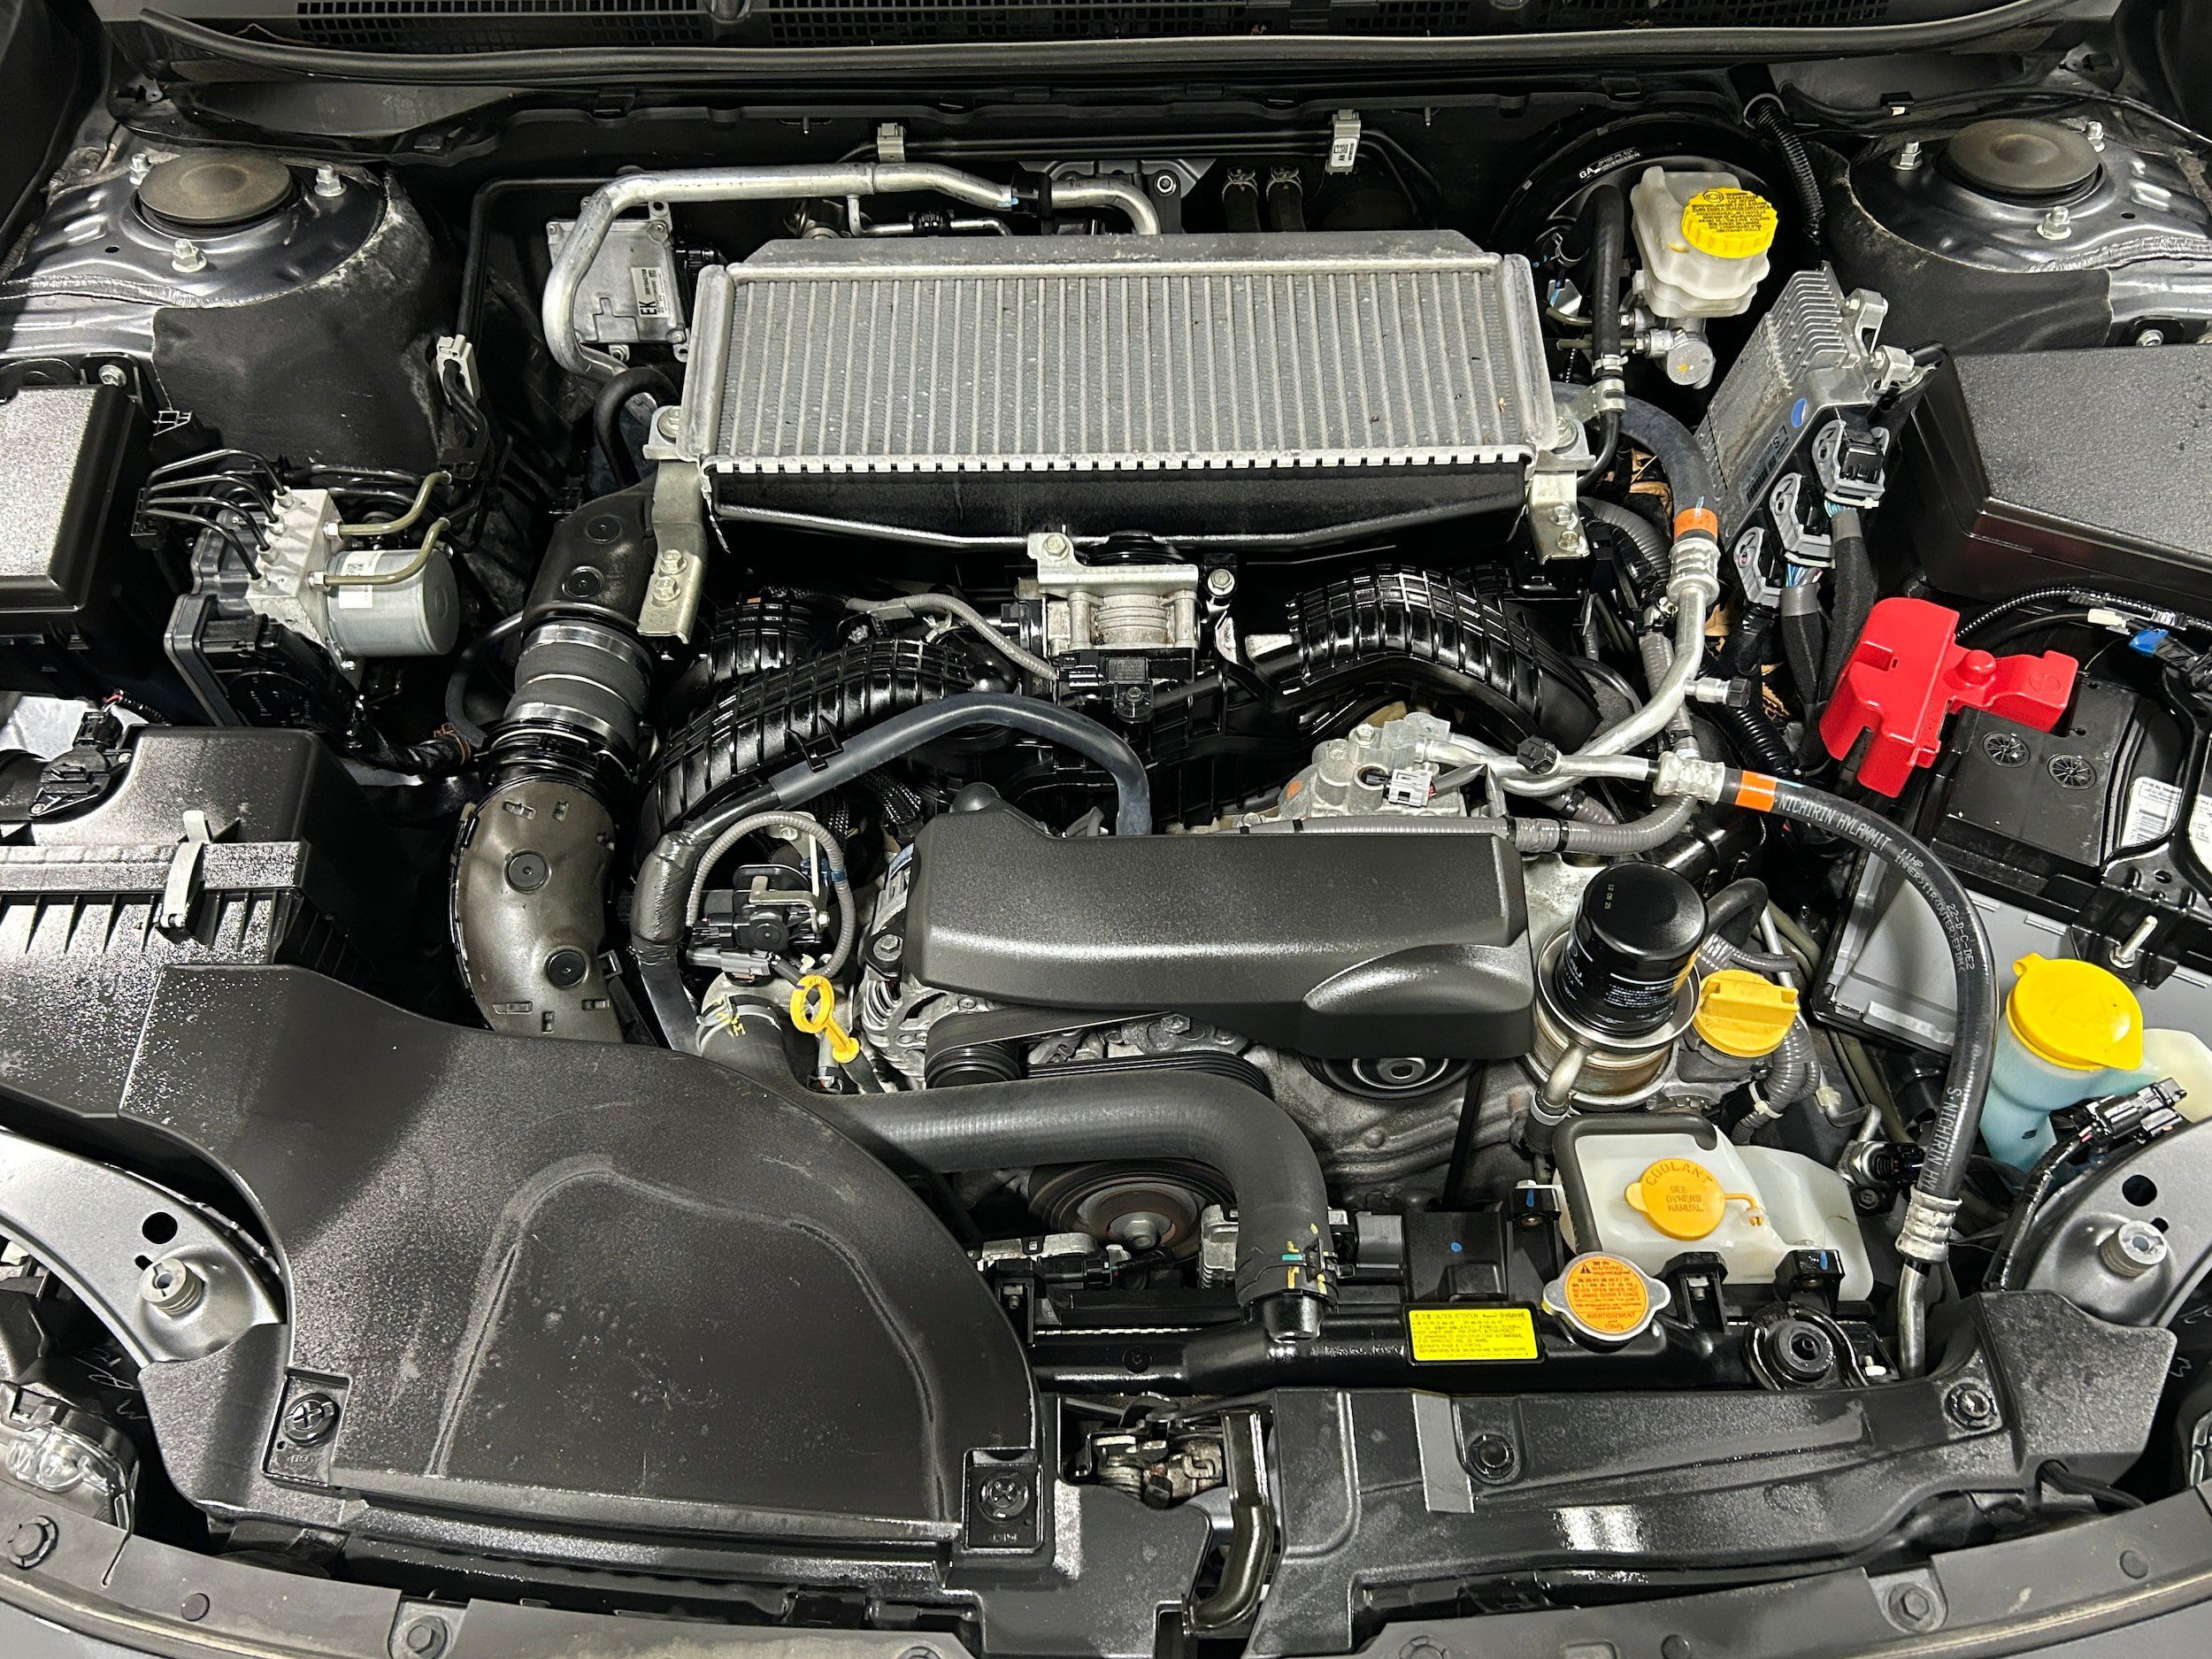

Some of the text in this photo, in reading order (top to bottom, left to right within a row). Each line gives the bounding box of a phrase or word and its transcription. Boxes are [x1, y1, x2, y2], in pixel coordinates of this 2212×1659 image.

[1579, 167, 1594, 179] GA
[639, 301, 657, 315] EK
[1778, 795, 1893, 850] NICHIRIN HYLAMMIT
[1900, 848, 1924, 868] 11HP
[1646, 1161, 1713, 1186] COOLANT
